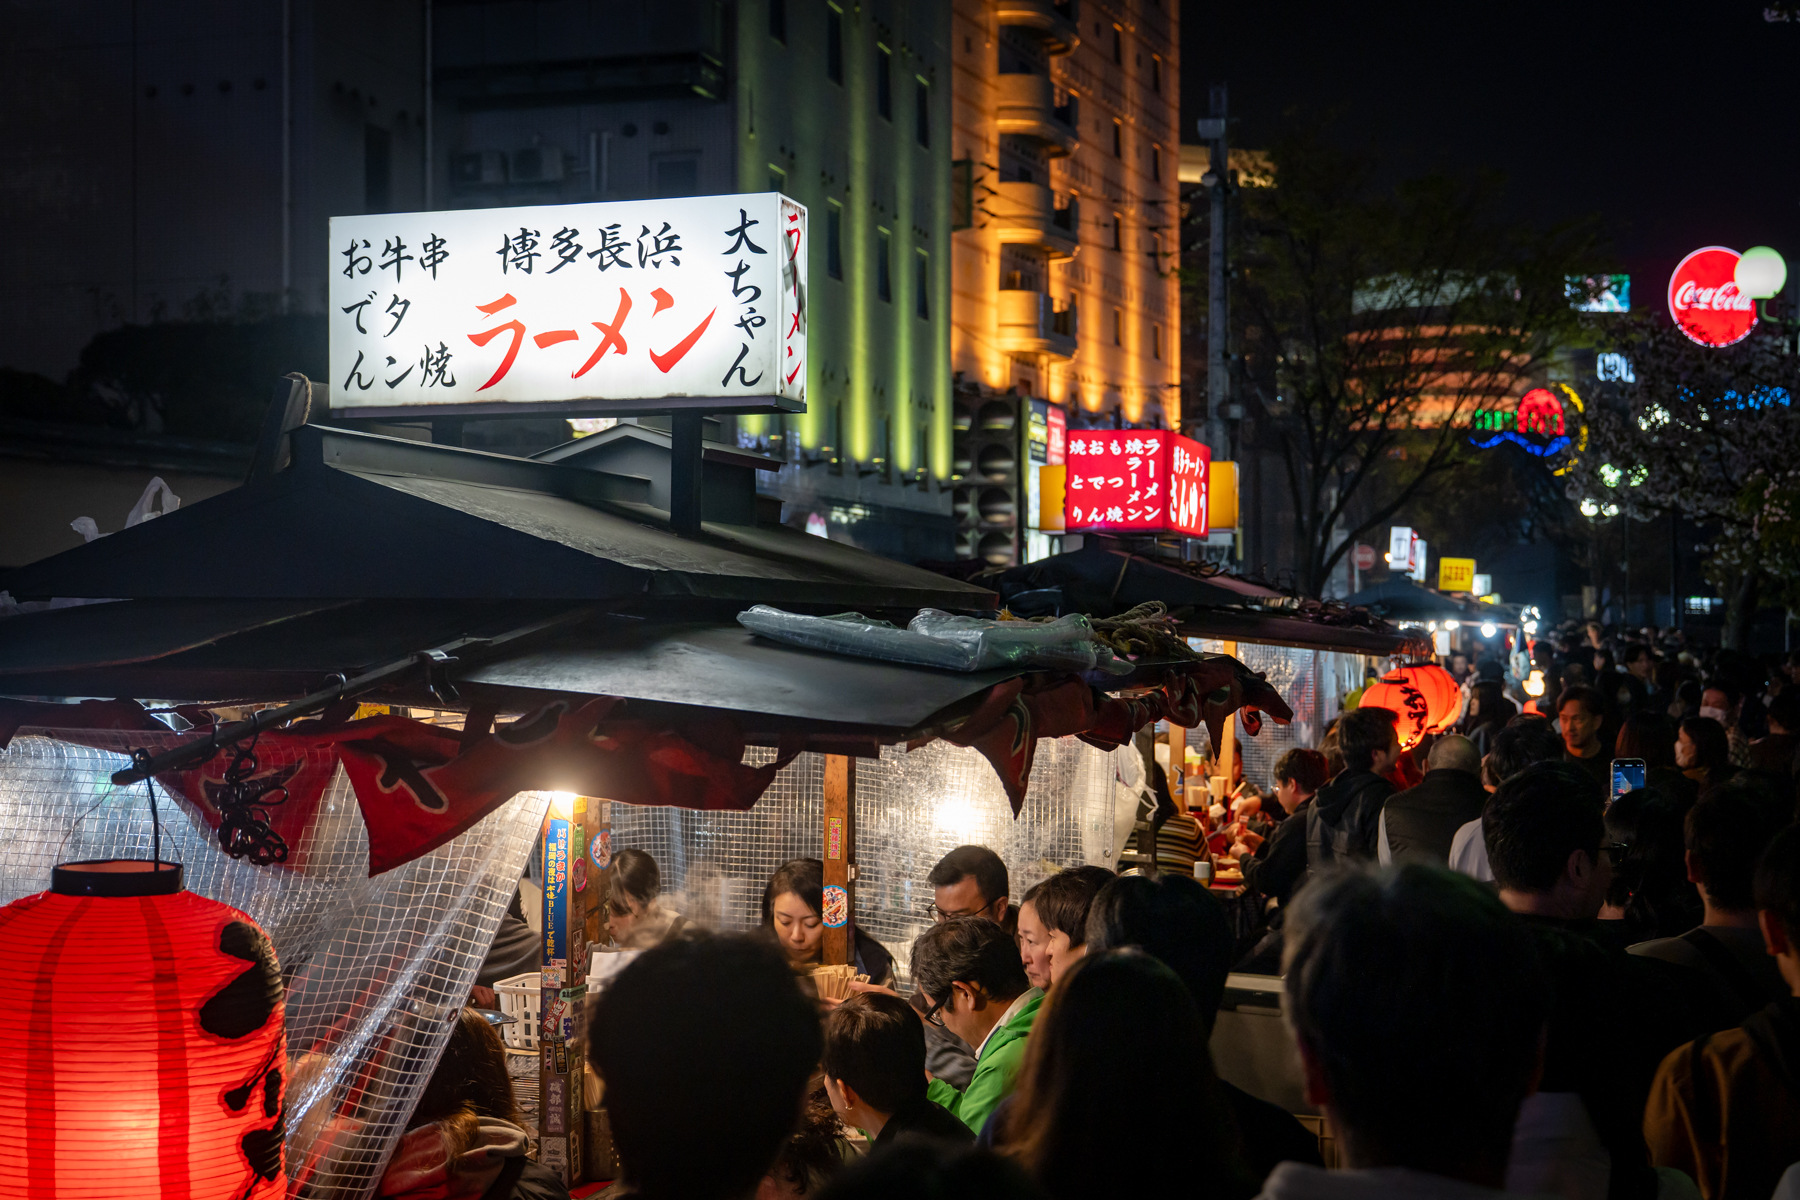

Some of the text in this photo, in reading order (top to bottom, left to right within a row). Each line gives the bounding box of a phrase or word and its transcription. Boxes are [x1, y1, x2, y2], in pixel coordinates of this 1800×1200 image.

[496, 221, 683, 275] 博多長浜
[341, 238, 375, 392] おでん
[377, 235, 414, 390] 牛タン
[466, 286, 717, 393] ラーメン
[721, 208, 768, 388] 大ちゃん
[786, 213, 802, 386] ラーメン
[1069, 438, 1087, 523] 焼とり
[1087, 439, 1105, 523] おでん
[1106, 439, 1124, 523] もつ焼
[1125, 438, 1144, 521] 焼ラーメン
[1144, 438, 1161, 522] ラーメン
